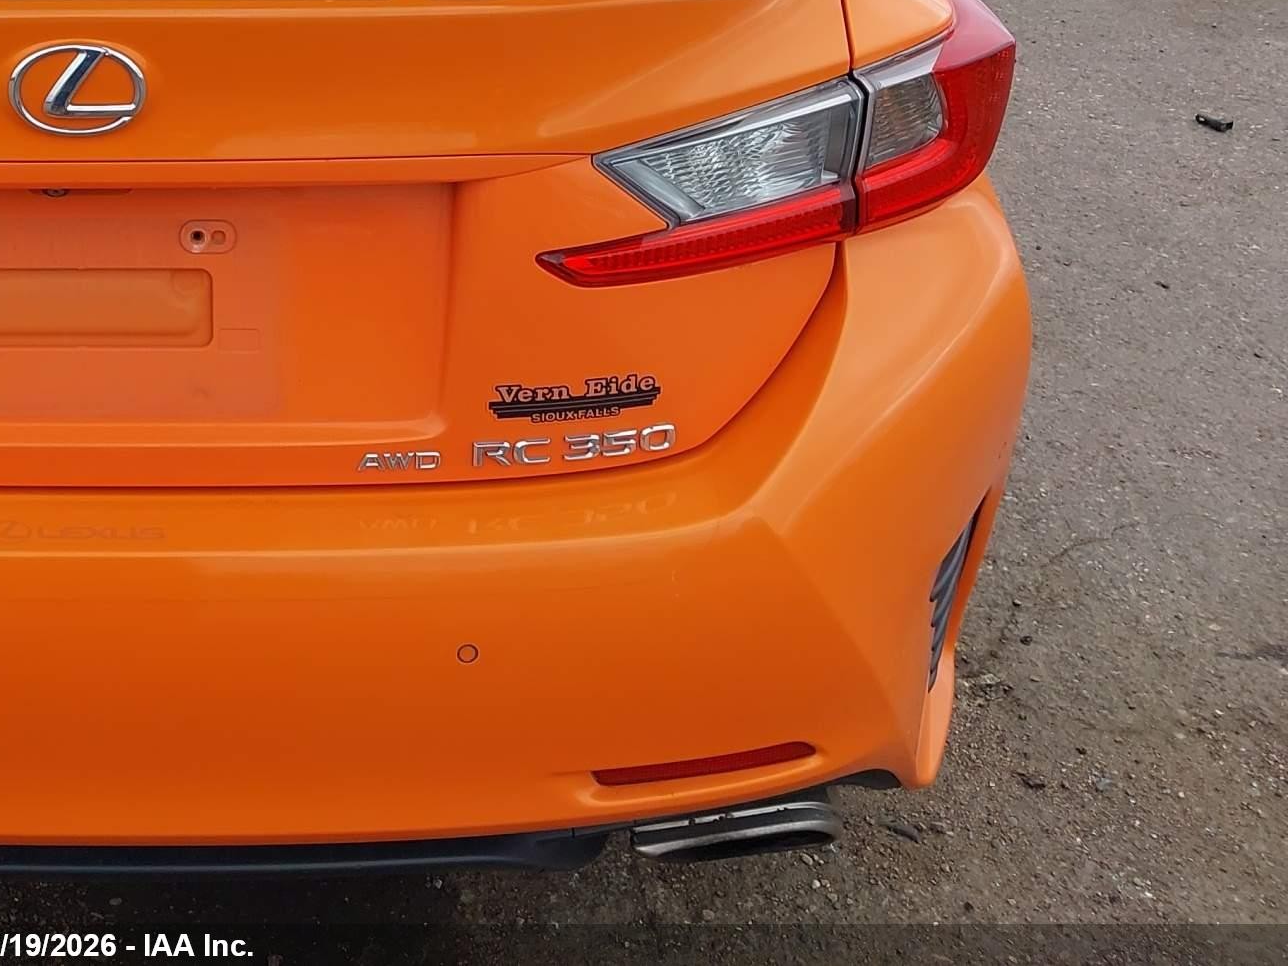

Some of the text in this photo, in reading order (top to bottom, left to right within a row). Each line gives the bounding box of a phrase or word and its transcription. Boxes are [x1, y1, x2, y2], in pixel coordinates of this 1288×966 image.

[494, 374, 657, 404] Vern Eide
[531, 405, 621, 423] SIOUX FALLS
[357, 423, 677, 472] AWD RC 350
